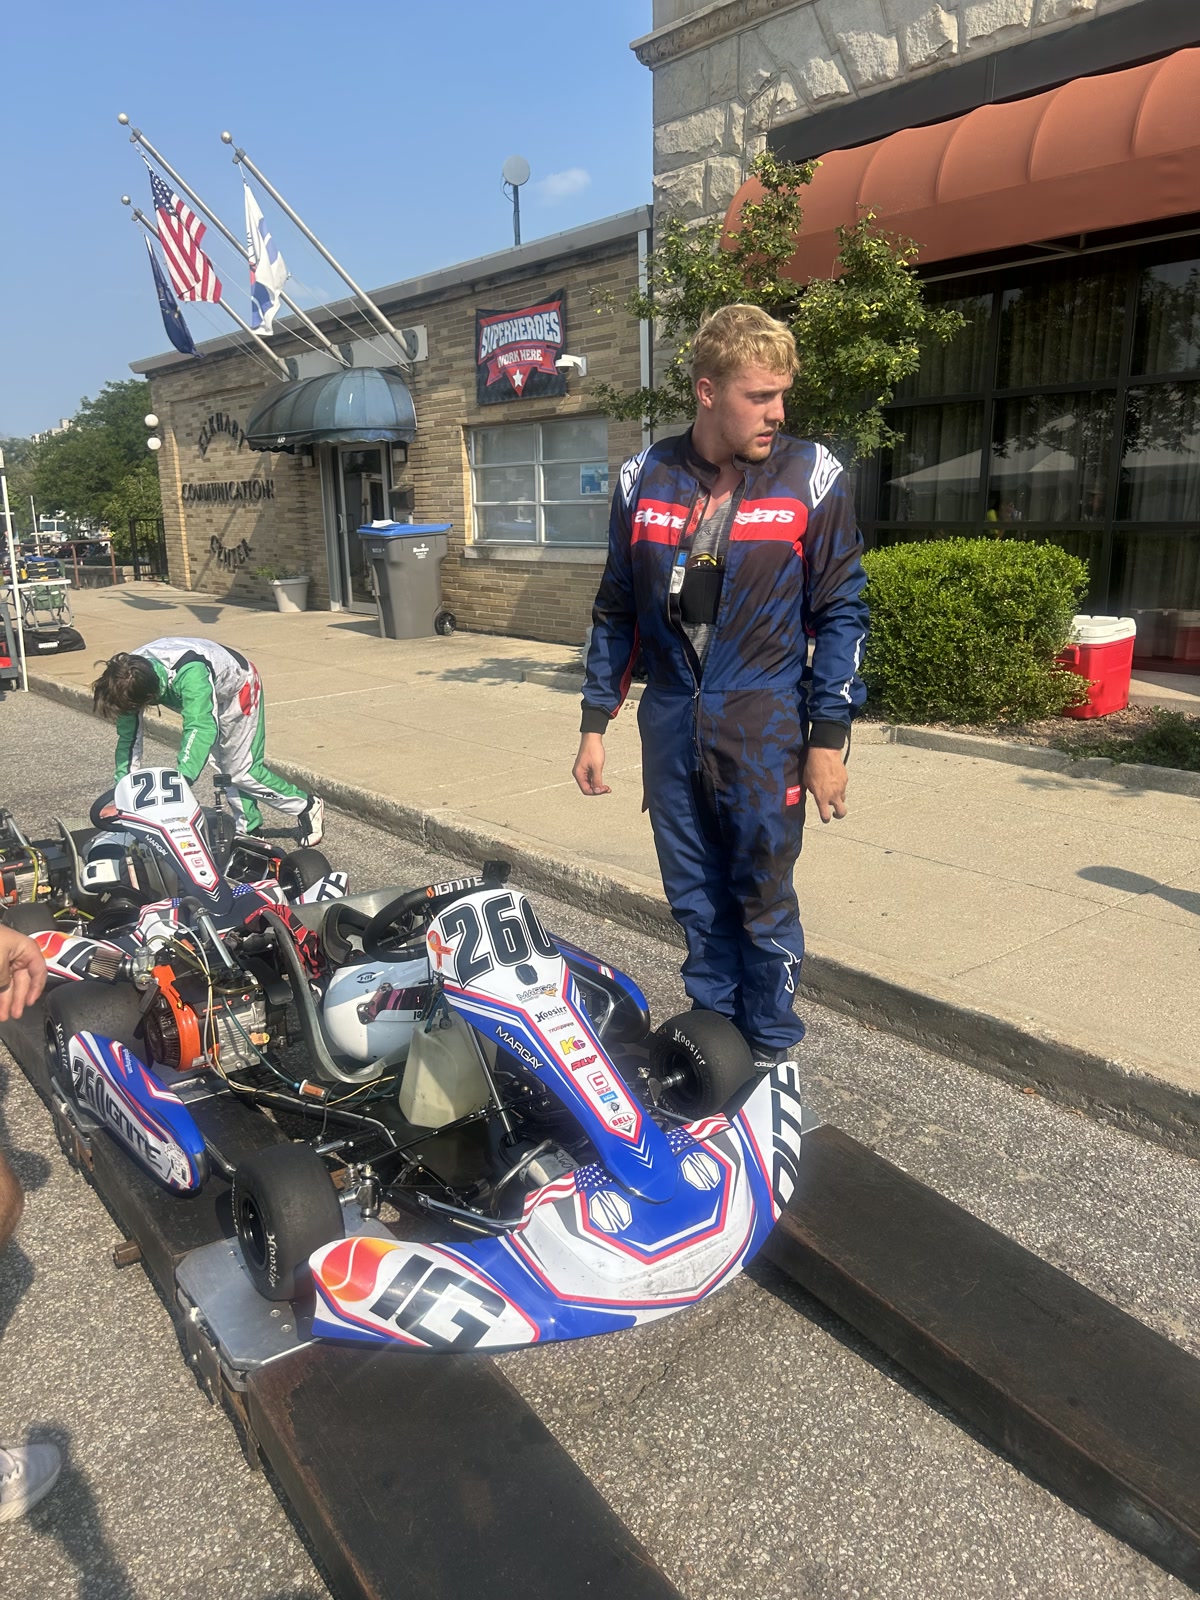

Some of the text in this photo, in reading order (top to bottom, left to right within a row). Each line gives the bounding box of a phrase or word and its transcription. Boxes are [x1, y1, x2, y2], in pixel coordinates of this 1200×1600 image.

[480, 311, 562, 359] SUPERHEROES
[497, 349, 544, 368] WORK HERE
[198, 412, 248, 456] ELKHART
[210, 534, 253, 568] CENTER
[130, 769, 184, 811] 25
[433, 876, 486, 898] IGNITE
[438, 892, 562, 990] 260
[495, 1025, 544, 1071] MARGAY
[571, 1054, 598, 1072] RLV
[105, 1092, 163, 1170] IGNITE
[611, 1114, 634, 1127] BELL
[368, 1254, 507, 1349] IG
